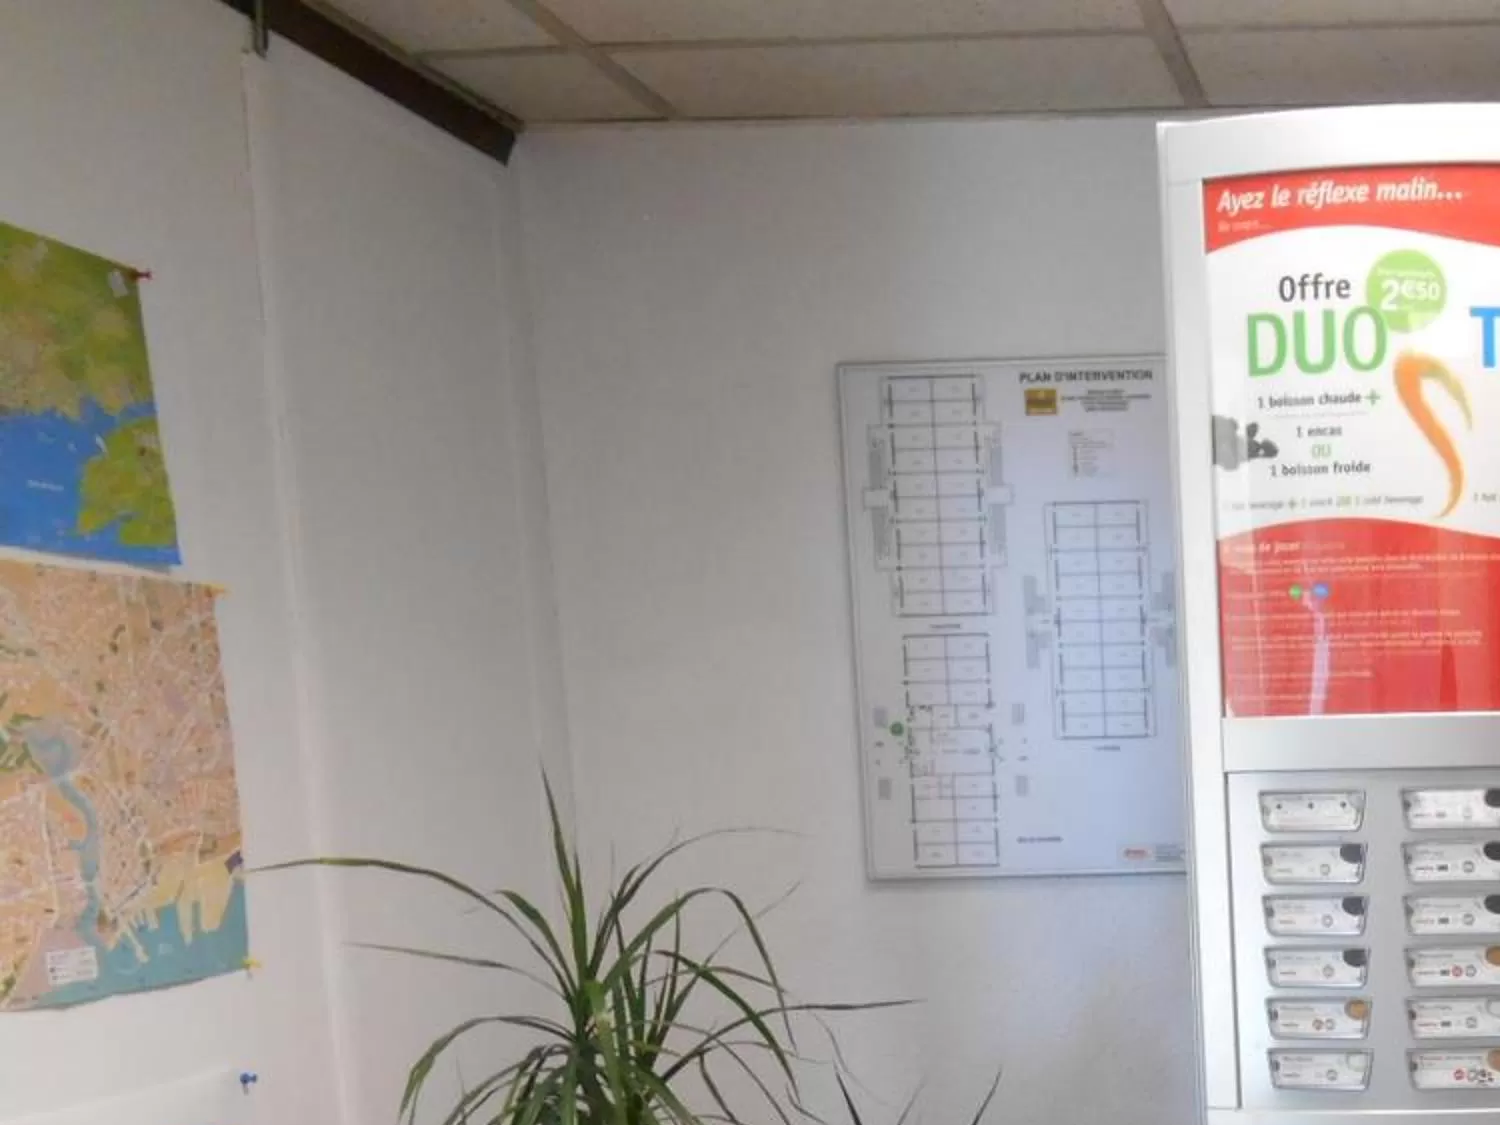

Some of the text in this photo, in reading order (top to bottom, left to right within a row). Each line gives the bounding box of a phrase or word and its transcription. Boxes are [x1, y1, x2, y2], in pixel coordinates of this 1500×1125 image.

[1217, 189, 1265, 216] Ayez
[1272, 184, 1290, 208] le
[1297, 180, 1370, 210] réflexe
[1279, 272, 1351, 302] Offre
[1247, 306, 1388, 377] DUO
[1019, 370, 1051, 384] PLAN
[1258, 397, 1265, 409] 1
[1269, 395, 1314, 408] boisson
[1318, 392, 1361, 405] chaude
[1307, 426, 1342, 437] encas
[1270, 461, 1371, 477] 1 boisson froide
